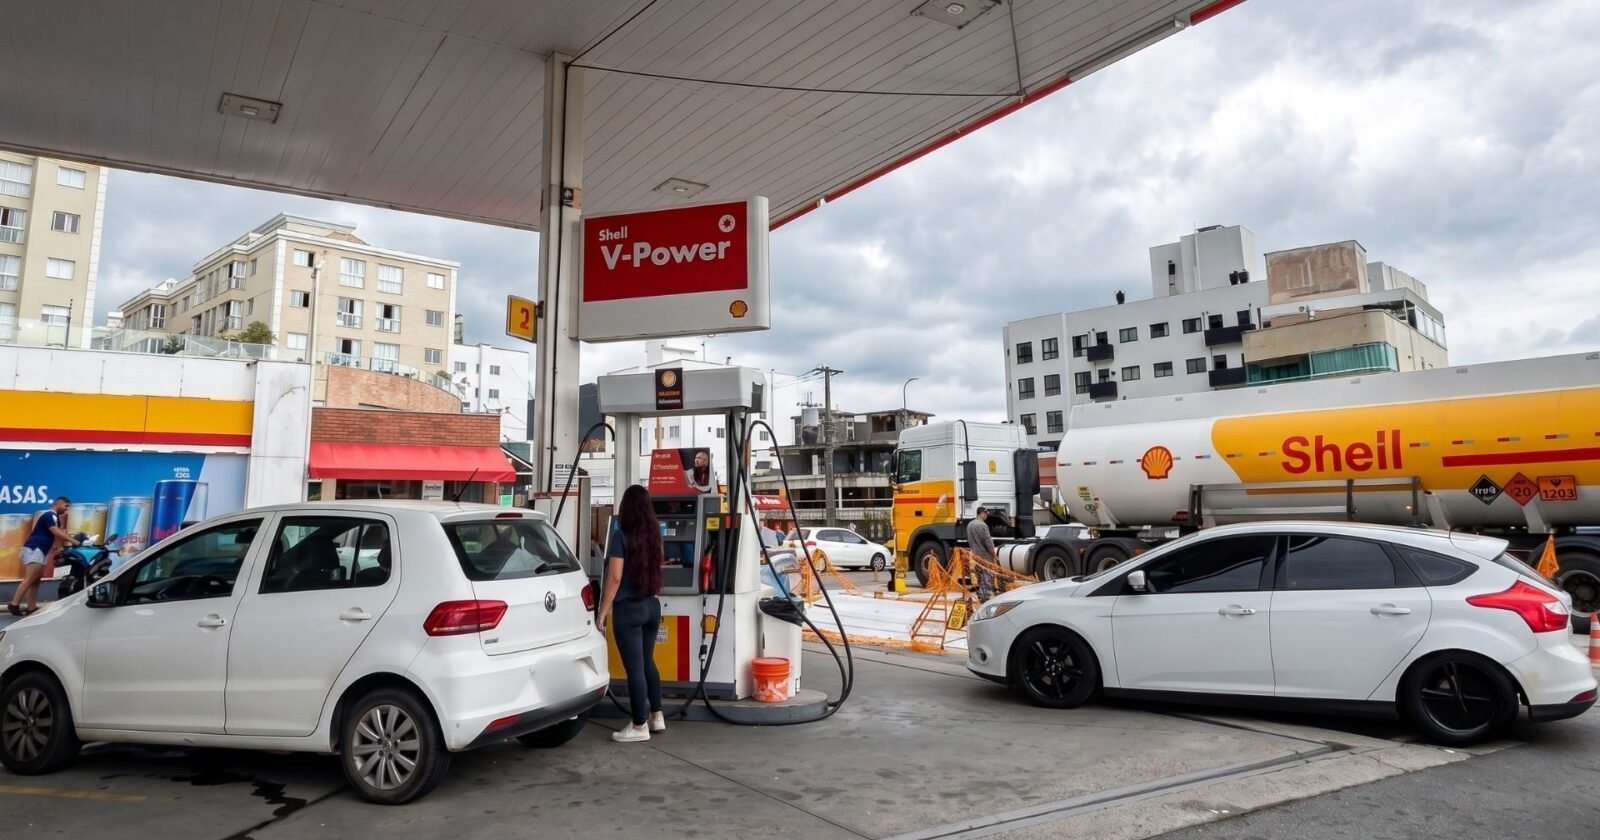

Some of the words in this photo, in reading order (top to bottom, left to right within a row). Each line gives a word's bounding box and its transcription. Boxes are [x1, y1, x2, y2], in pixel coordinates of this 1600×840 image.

[599, 226, 628, 241] Shell
[600, 239, 731, 270] V-Power
[519, 307, 530, 330] 2
[1281, 429, 1403, 475] Shell
[1542, 488, 1575, 499] 1203
